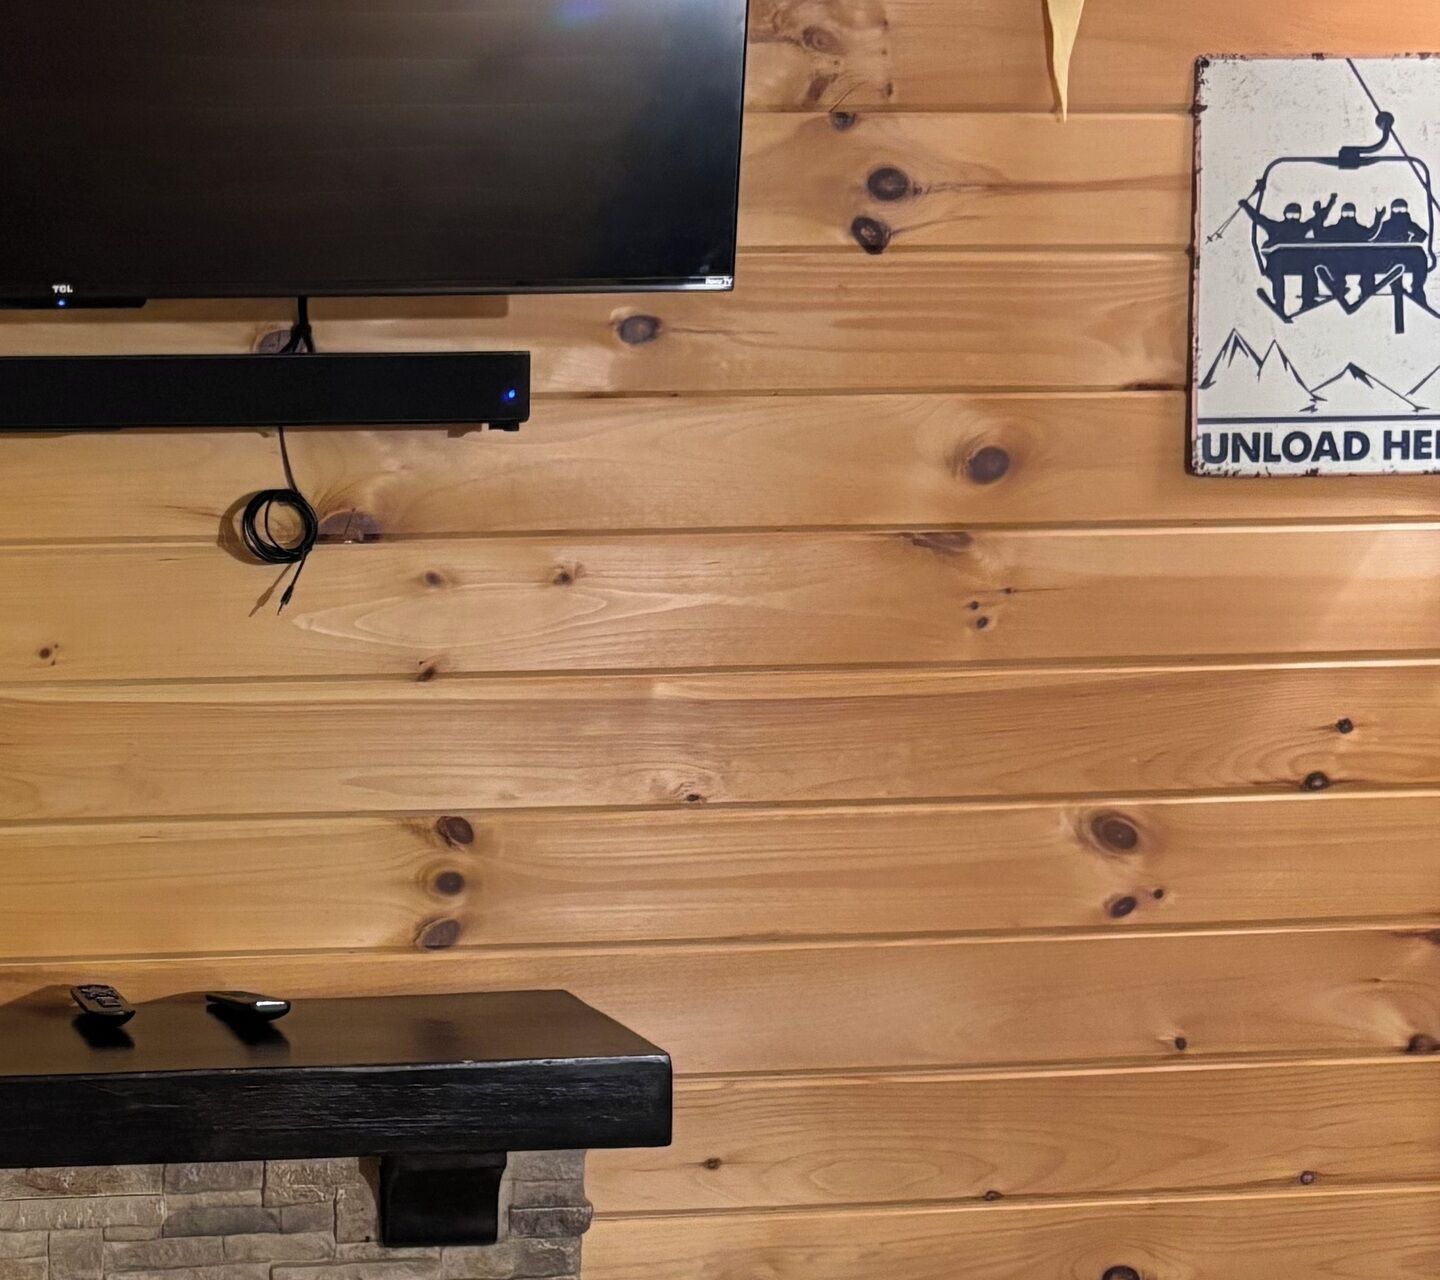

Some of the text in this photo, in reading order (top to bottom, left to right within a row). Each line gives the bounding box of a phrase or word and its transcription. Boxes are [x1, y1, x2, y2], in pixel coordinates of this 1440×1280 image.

[52, 284, 73, 293] TCL
[1202, 430, 1440, 464] UNLOAD HE
